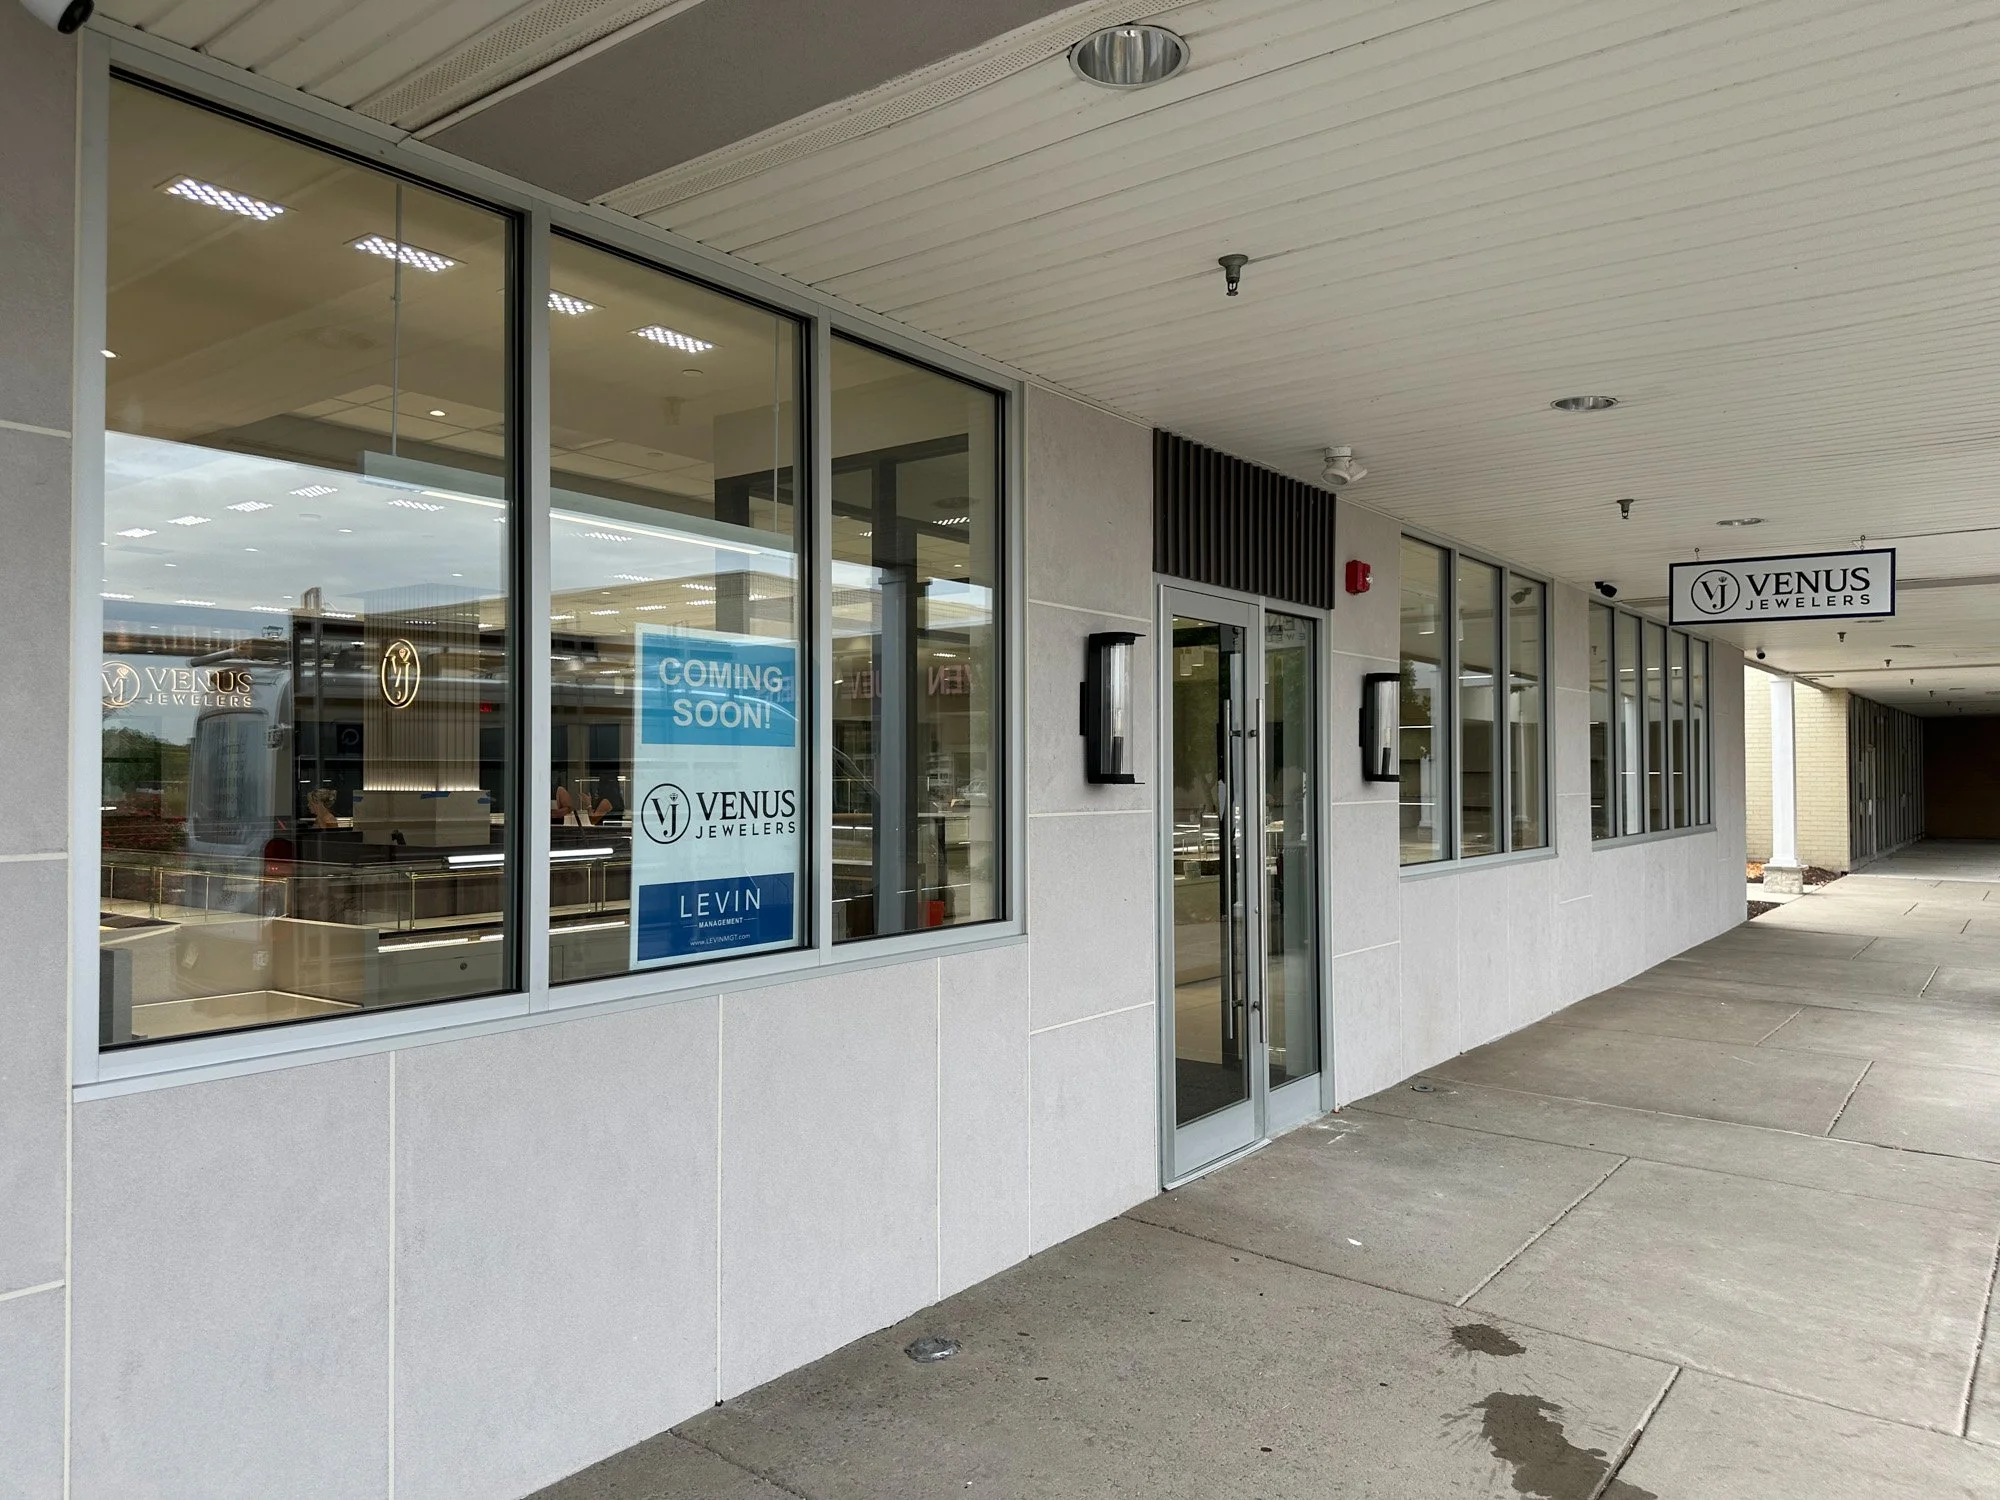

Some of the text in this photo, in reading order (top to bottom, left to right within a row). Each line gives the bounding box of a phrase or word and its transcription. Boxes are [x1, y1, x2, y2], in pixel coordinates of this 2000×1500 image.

[1746, 567, 1871, 596] VENUS
[1745, 594, 1871, 611] JEWELERS
[145, 667, 254, 695] VENUS
[659, 657, 783, 693] COMING
[145, 692, 254, 708] JEWELERS
[672, 698, 771, 729] SOON!
[695, 789, 796, 821] VENUS
[695, 821, 796, 839] JEWELERS
[680, 887, 761, 918] LEVIN
[698, 917, 743, 928] MANAGEMENT
[689, 934, 751, 946] www.LEVINMGT.com
